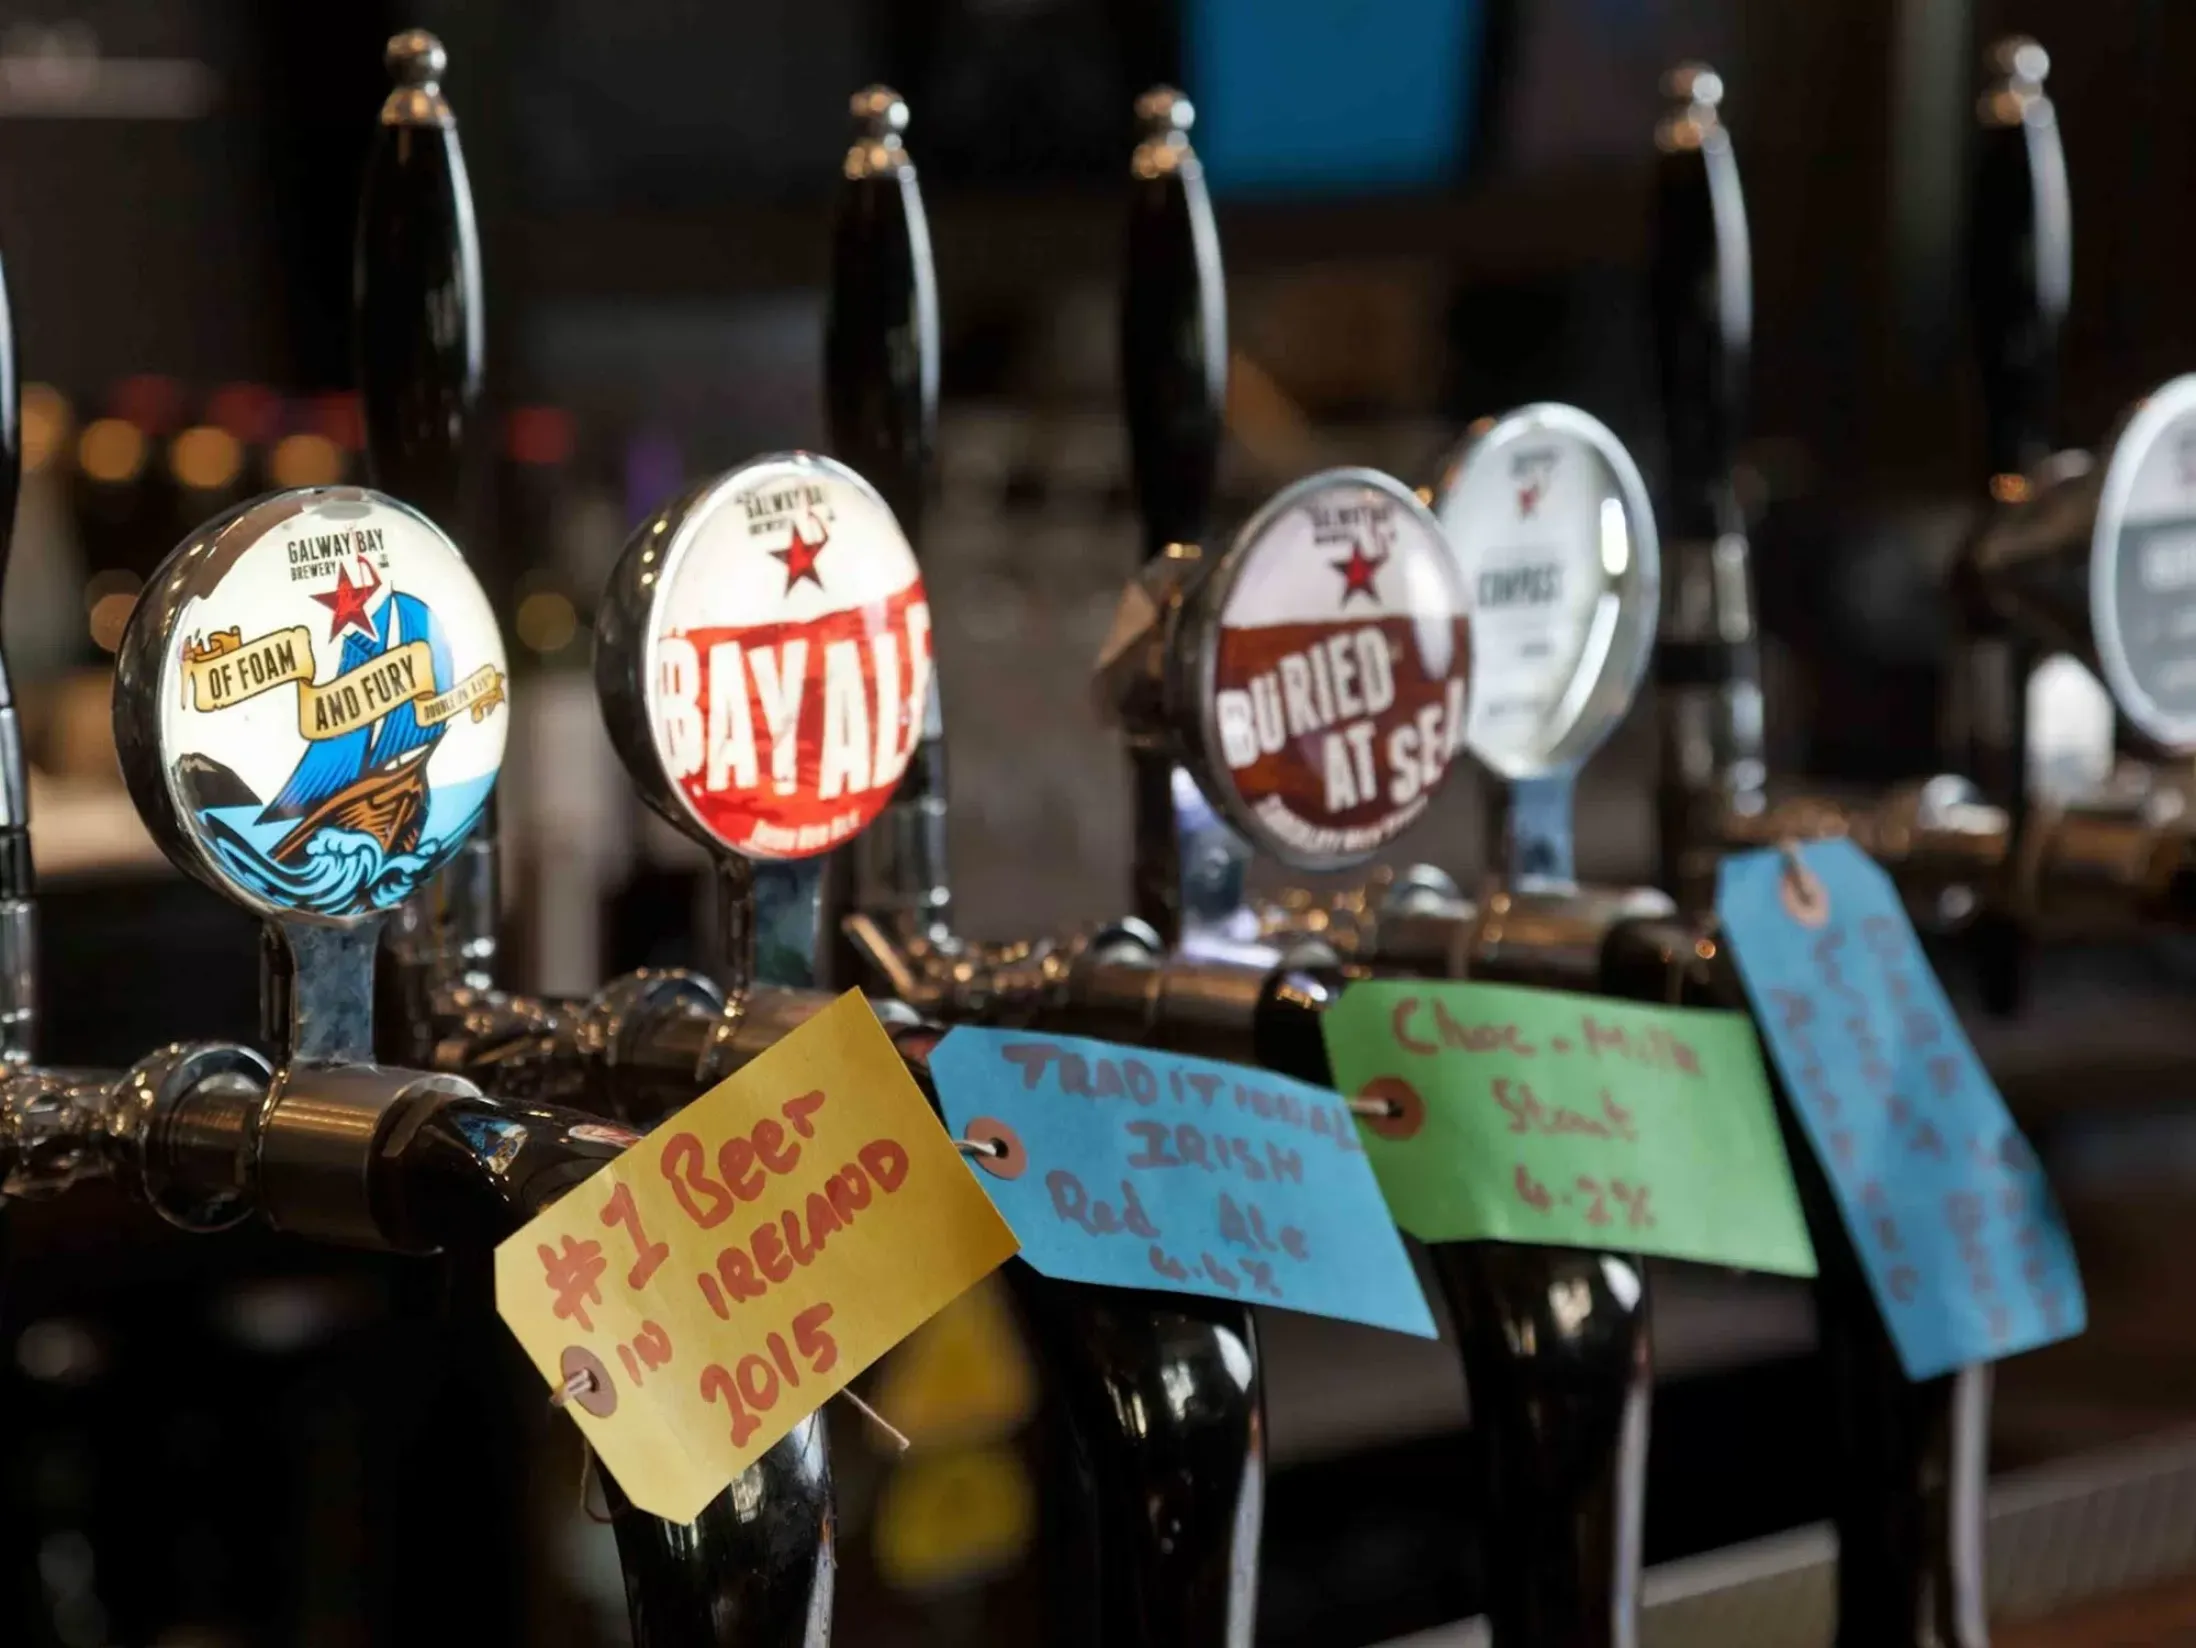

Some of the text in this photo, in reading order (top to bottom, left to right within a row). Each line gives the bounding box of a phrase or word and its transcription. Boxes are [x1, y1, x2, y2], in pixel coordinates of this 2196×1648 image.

[287, 532, 351, 564] GALWAY
[355, 528, 384, 553] BAY
[290, 560, 337, 582] BREWERY
[208, 638, 297, 702] OF FOAM
[314, 686, 363, 732] AND
[364, 654, 419, 713] FURY
[657, 636, 808, 796] BAY
[1215, 626, 1396, 771] BURIED
[1321, 721, 1378, 814] AT
[1125, 1117, 1305, 1186] IRISH
[536, 1181, 670, 1333] #1
[616, 1137, 910, 1388] IN IRELAND
[1044, 1168, 1311, 1263] Red Ale
[699, 1301, 839, 1449] 2015
